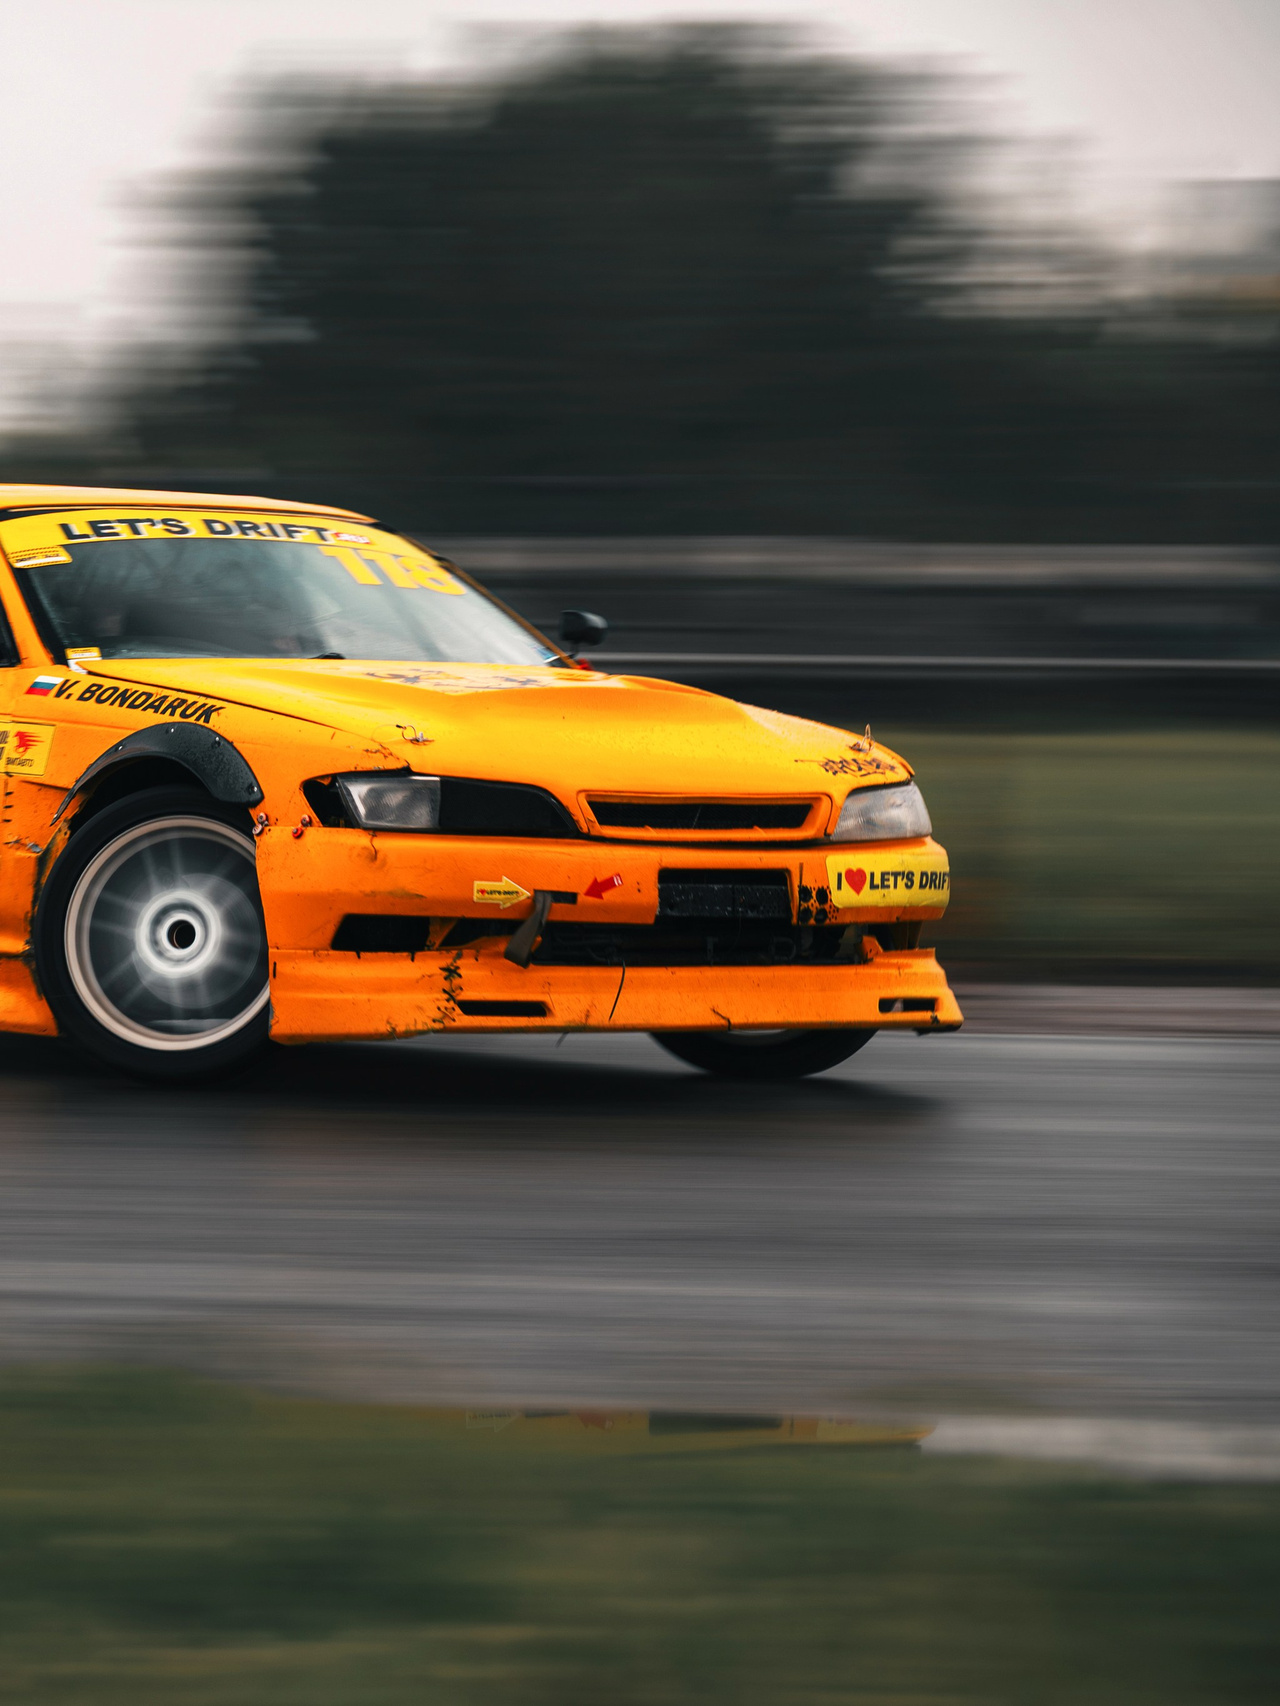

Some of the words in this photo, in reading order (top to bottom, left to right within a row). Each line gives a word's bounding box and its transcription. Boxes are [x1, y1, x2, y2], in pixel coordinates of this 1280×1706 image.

[58, 518, 192, 541] LET'S
[202, 518, 331, 543] DRIFT
[318, 546, 467, 595] 118
[53, 679, 81, 698] V.
[77, 683, 226, 723] BONDARUK
[869, 871, 915, 890] LET'S
